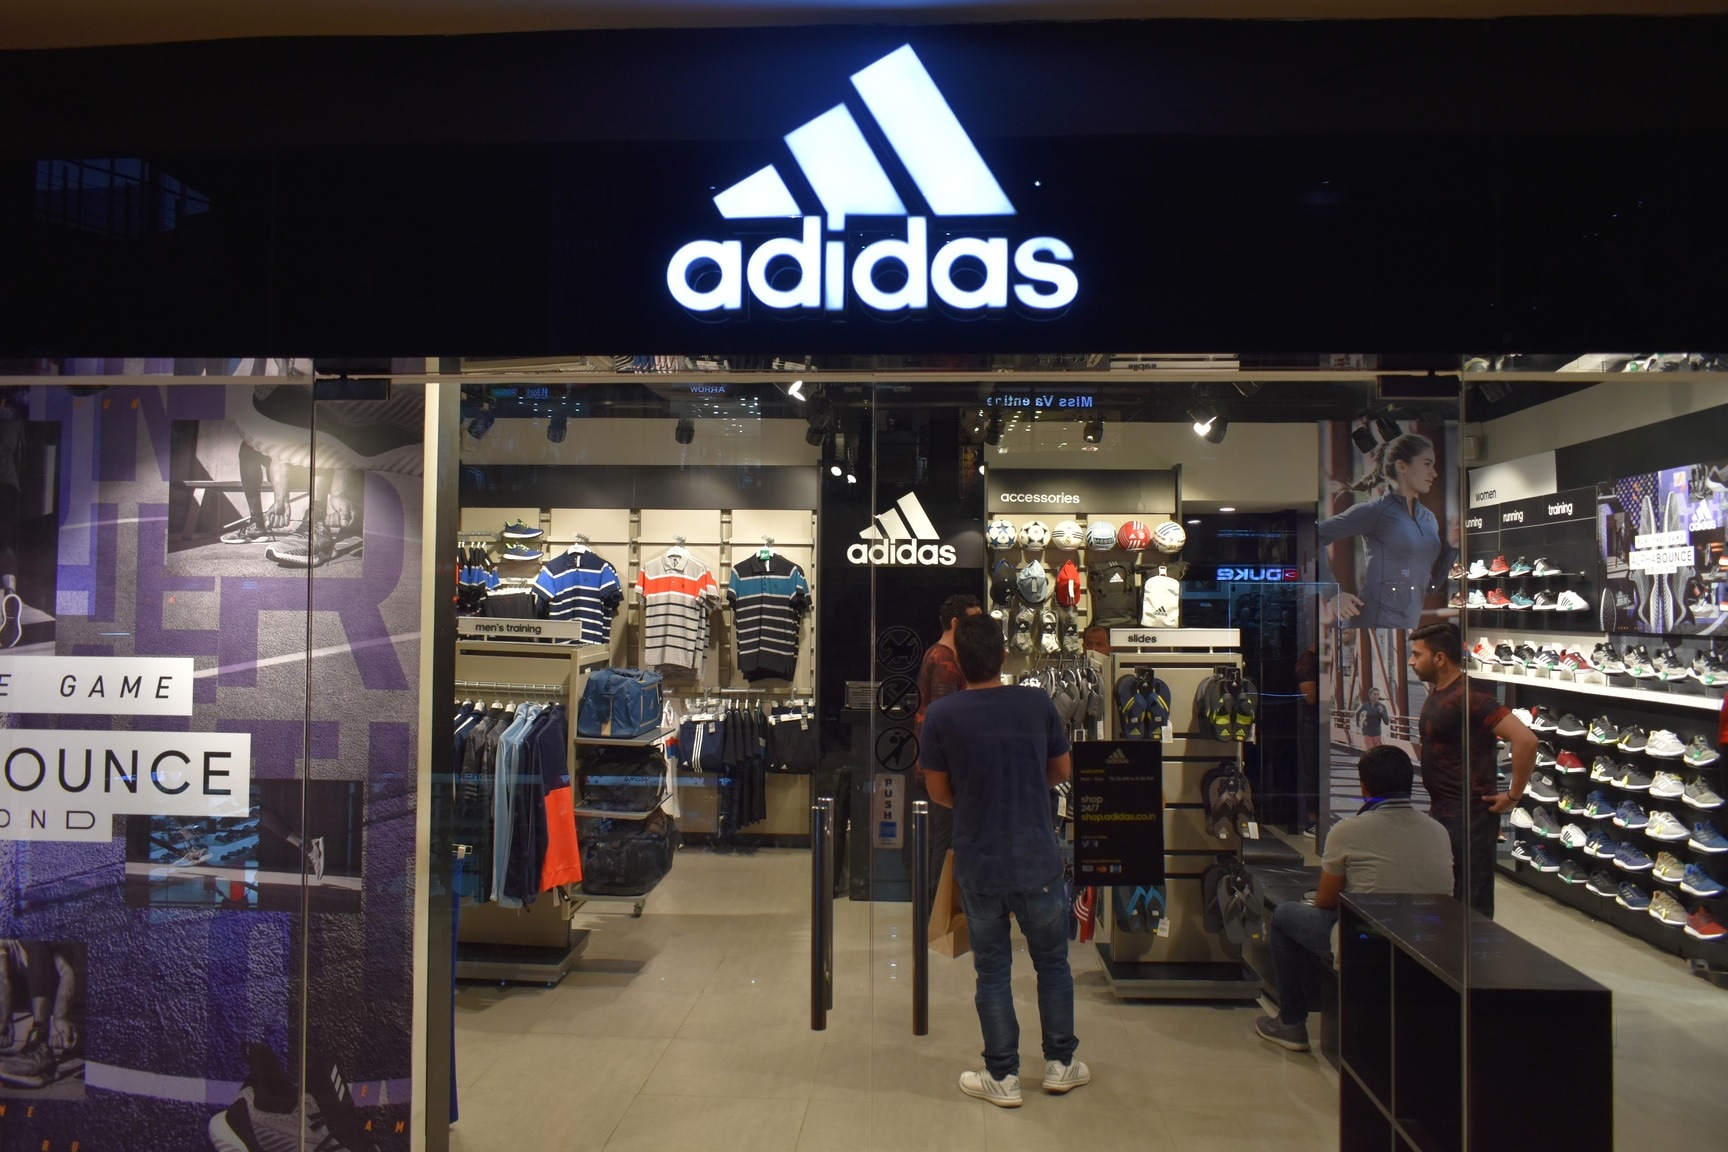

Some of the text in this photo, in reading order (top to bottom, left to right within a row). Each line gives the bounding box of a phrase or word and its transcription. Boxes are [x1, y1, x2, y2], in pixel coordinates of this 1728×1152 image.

[667, 216, 1078, 310] adidas
[1000, 491, 1080, 504] accessories
[1475, 489, 1497, 502] women
[1548, 502, 1573, 516] training
[1465, 517, 1483, 529] unning
[1503, 510, 1524, 523] running
[847, 538, 956, 565] adidas
[475, 622, 542, 635] men's training
[1127, 634, 1157, 643] slides
[60, 674, 174, 699] GAME
[884, 778, 892, 819] PUSH
[1080, 795, 1103, 804] shop
[1080, 804, 1100, 812] 24/7
[1081, 812, 1157, 822] shop.adidas.co.in
